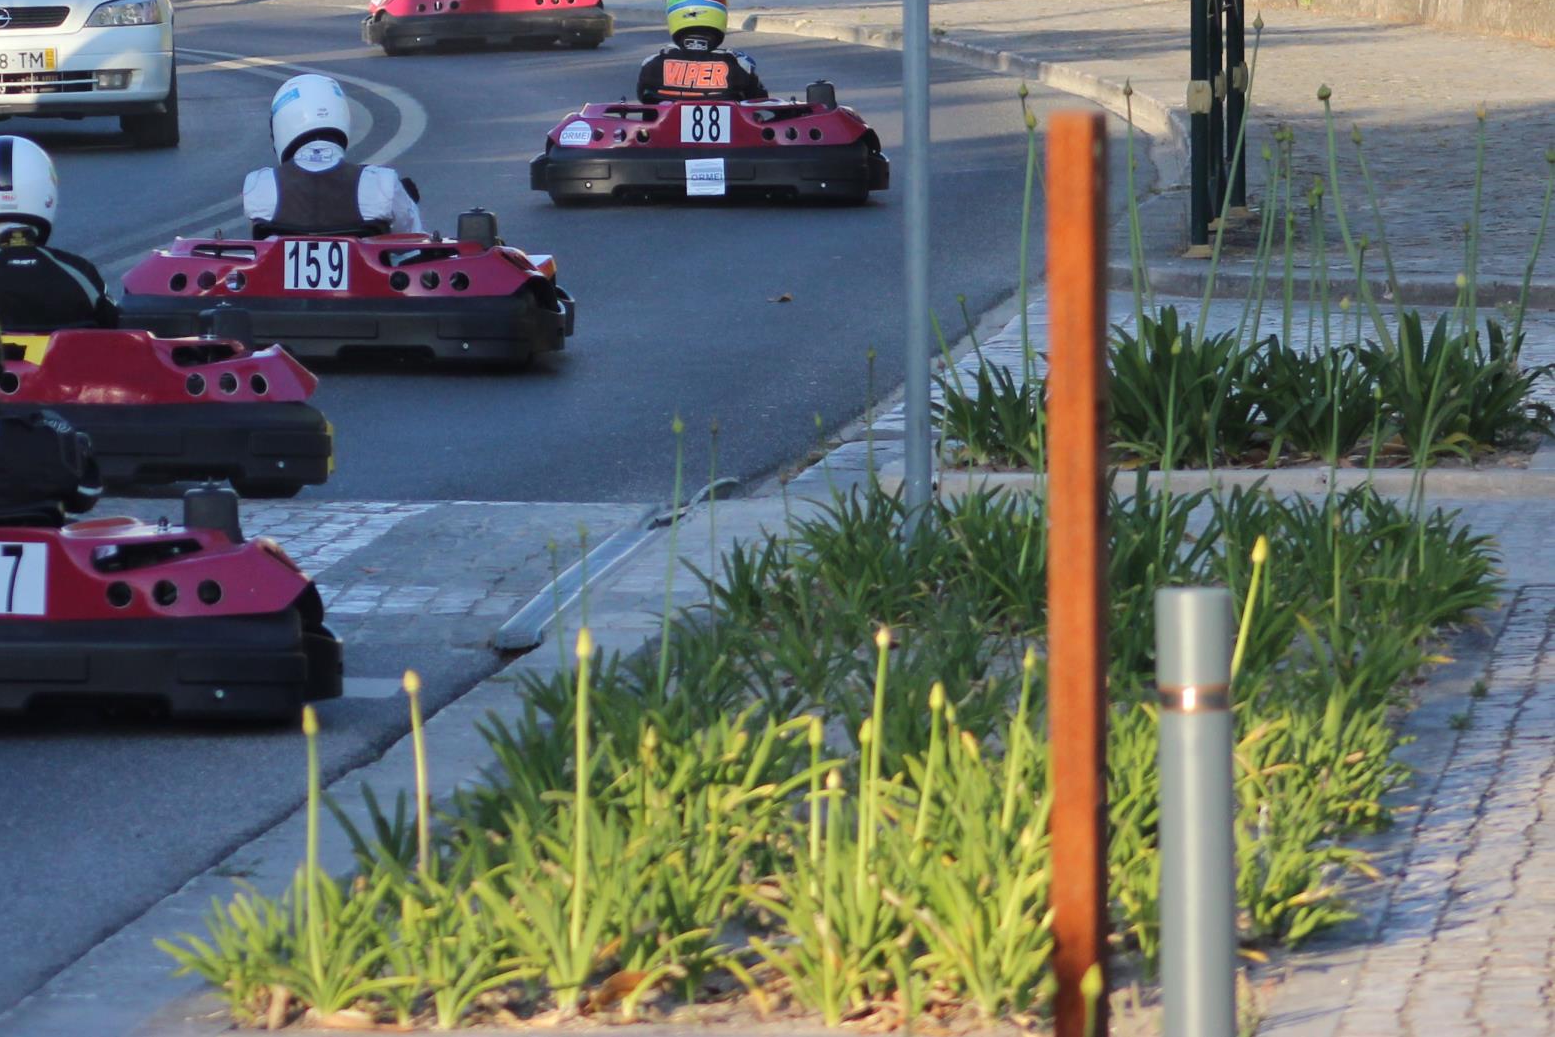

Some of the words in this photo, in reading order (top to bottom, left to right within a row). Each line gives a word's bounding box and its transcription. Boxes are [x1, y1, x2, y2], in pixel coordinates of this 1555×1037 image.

[663, 59, 729, 89] VIPER
[692, 105, 720, 142] 88
[288, 241, 344, 288] 159
